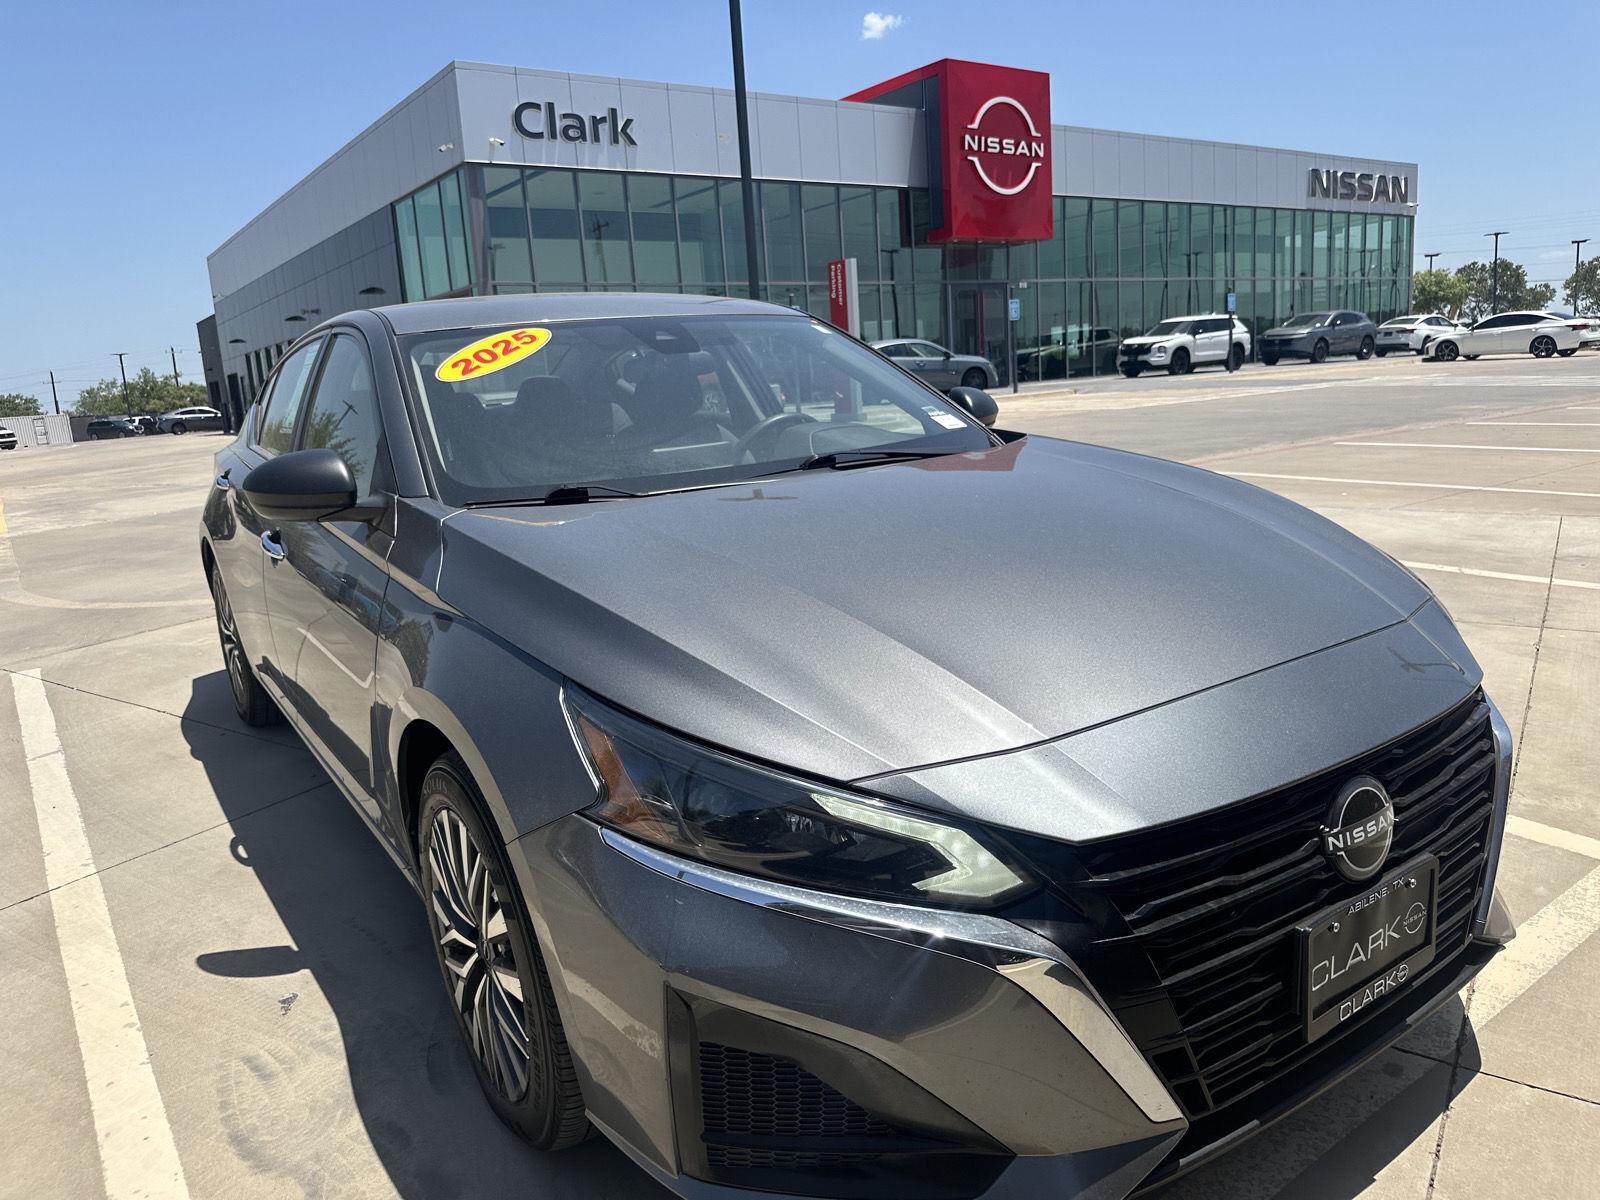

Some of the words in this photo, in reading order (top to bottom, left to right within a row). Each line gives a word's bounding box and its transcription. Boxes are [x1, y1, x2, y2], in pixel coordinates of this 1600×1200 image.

[512, 101, 637, 146] Clark
[964, 134, 1044, 157] NISSAN
[1308, 168, 1408, 203] NISSAN
[451, 331, 537, 376] 2025
[1327, 811, 1394, 851] NISSAN
[1392, 876, 1404, 890] TX
[1403, 909, 1428, 926] NISSAN
[1312, 915, 1401, 992] CLARK
[1339, 971, 1397, 1022] CLARK
